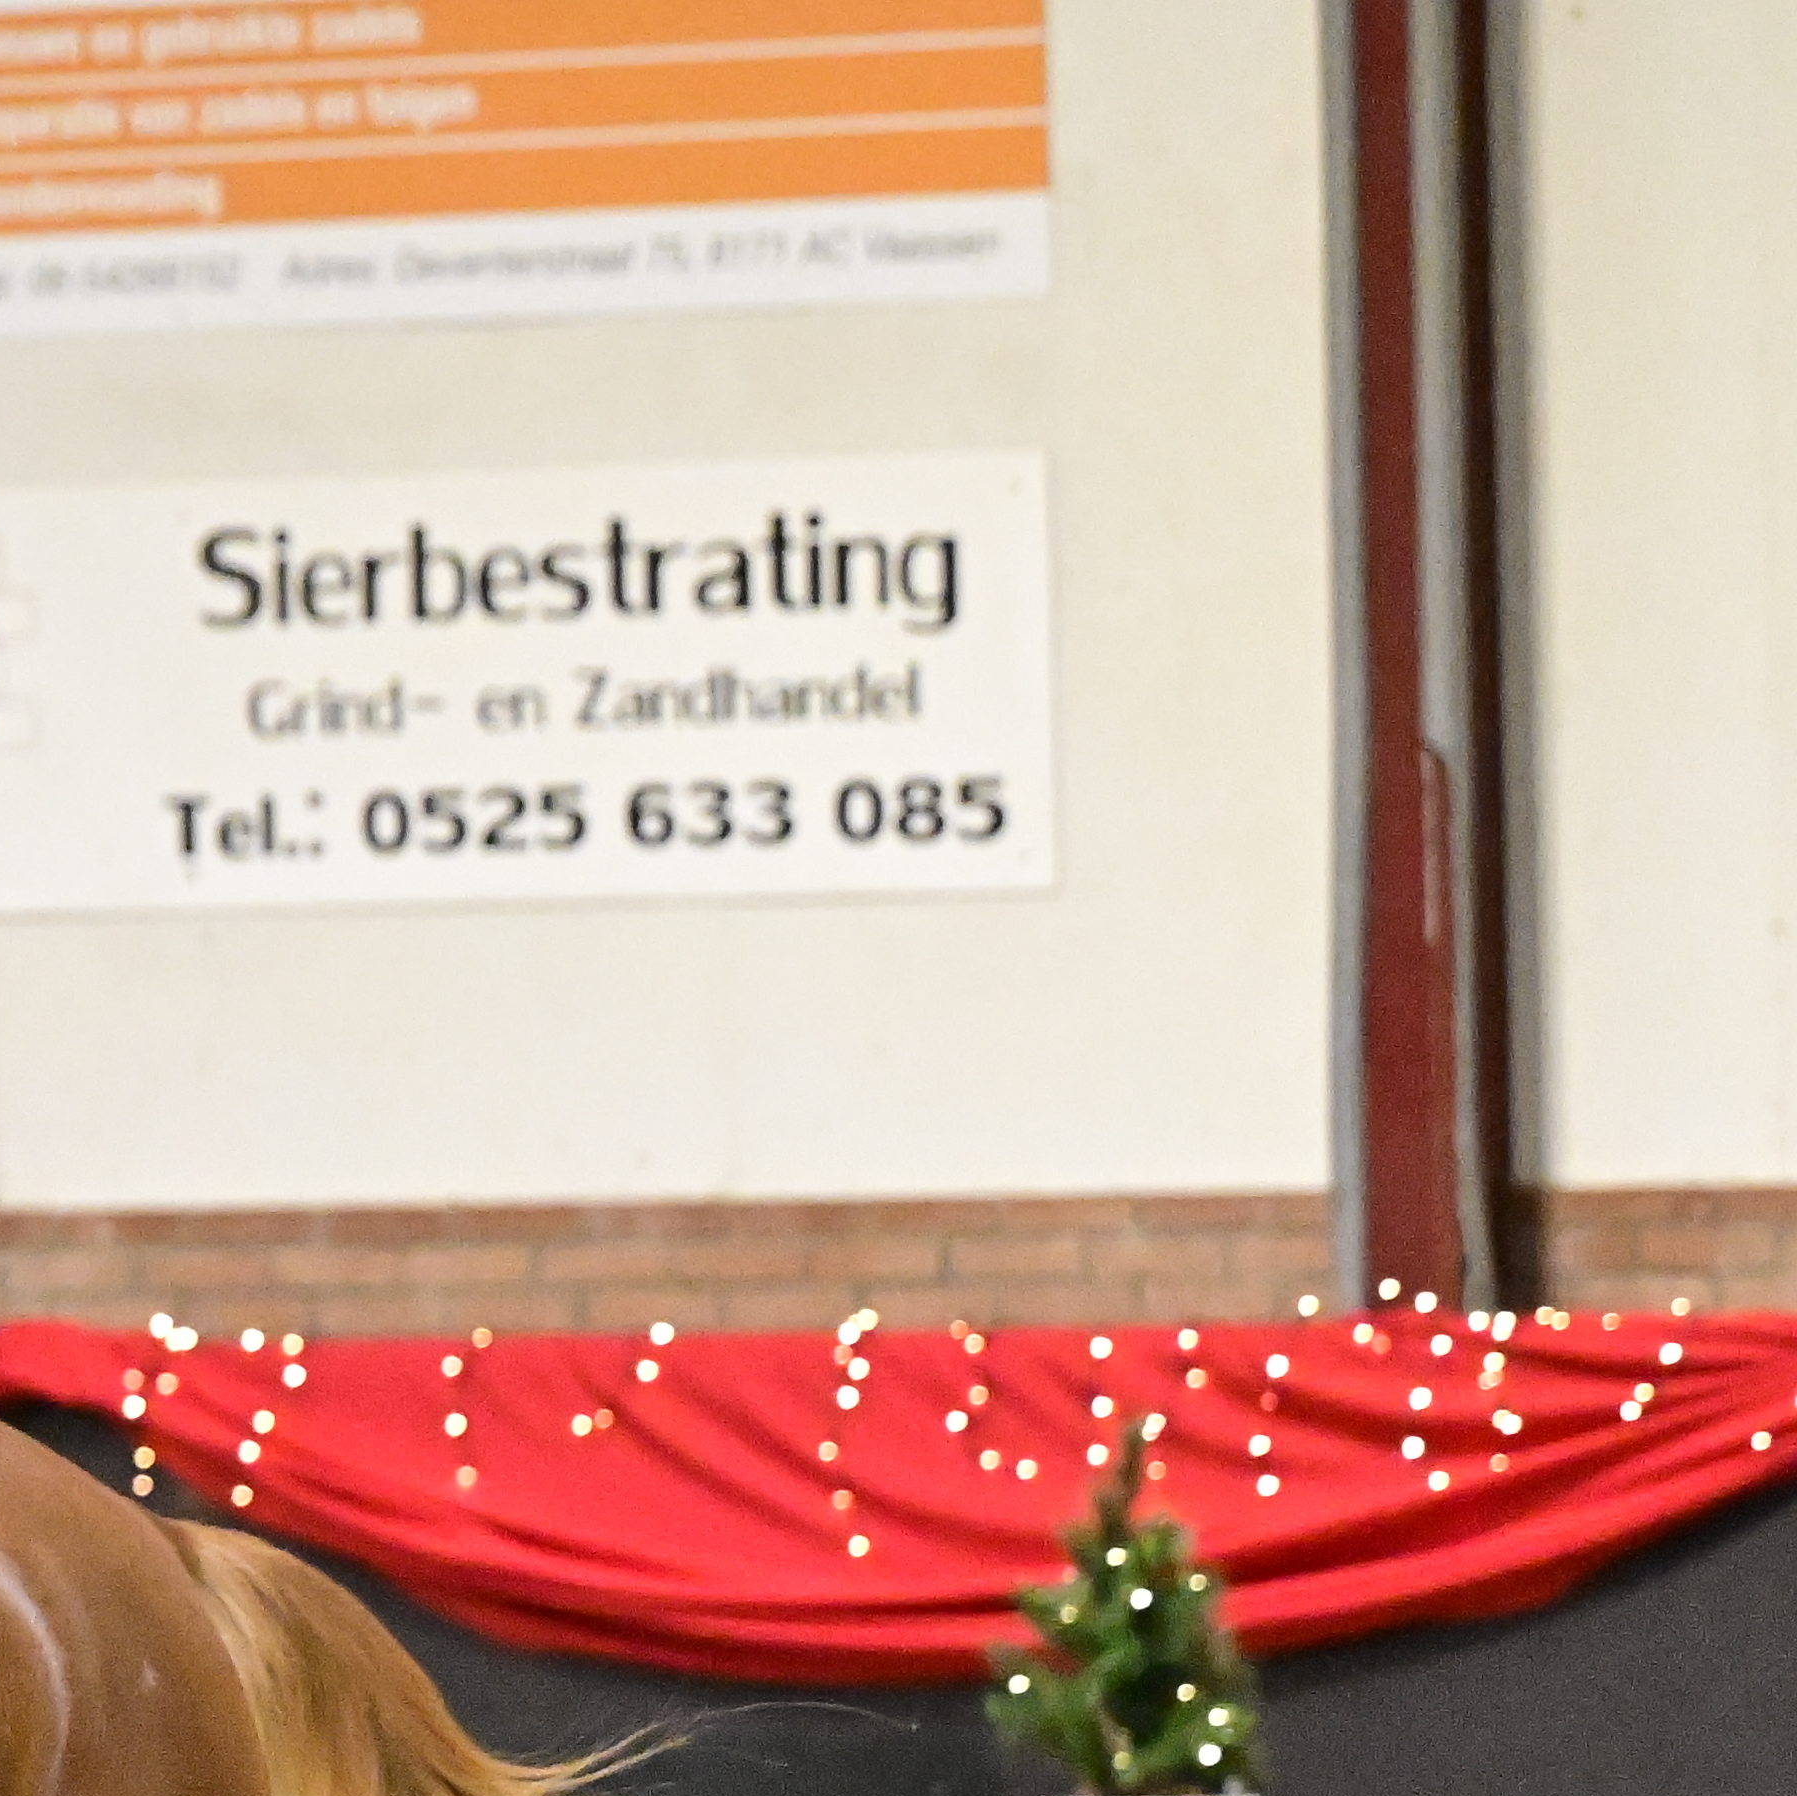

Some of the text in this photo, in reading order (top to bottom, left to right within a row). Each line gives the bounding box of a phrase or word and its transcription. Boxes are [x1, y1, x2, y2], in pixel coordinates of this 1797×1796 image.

[198, 511, 957, 632] Sierbestrating
[475, 688, 548, 734] en
[572, 660, 923, 736] Zandhandel
[361, 785, 587, 855] 0525
[624, 779, 796, 848] 633
[833, 776, 1007, 845] 085
